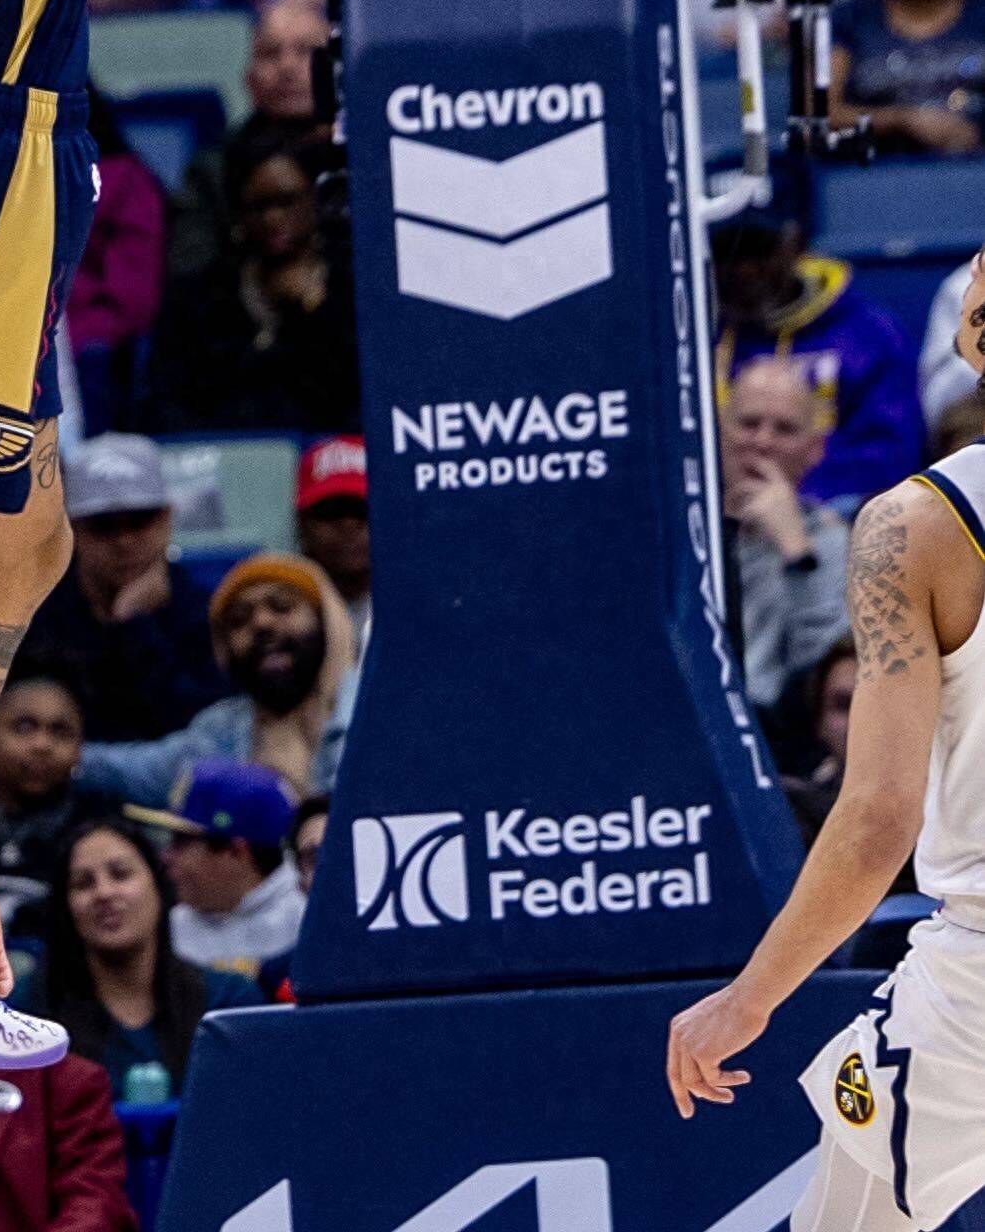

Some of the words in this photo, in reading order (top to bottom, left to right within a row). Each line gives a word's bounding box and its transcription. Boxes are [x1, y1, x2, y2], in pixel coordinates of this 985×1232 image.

[387, 80, 604, 133] Chevron
[657, 23, 696, 431] PRODUCTS
[392, 389, 629, 454] NEWAGE
[414, 450, 608, 492] PRODUCTS
[485, 794, 712, 858] Keesler
[488, 851, 711, 920] Federal
